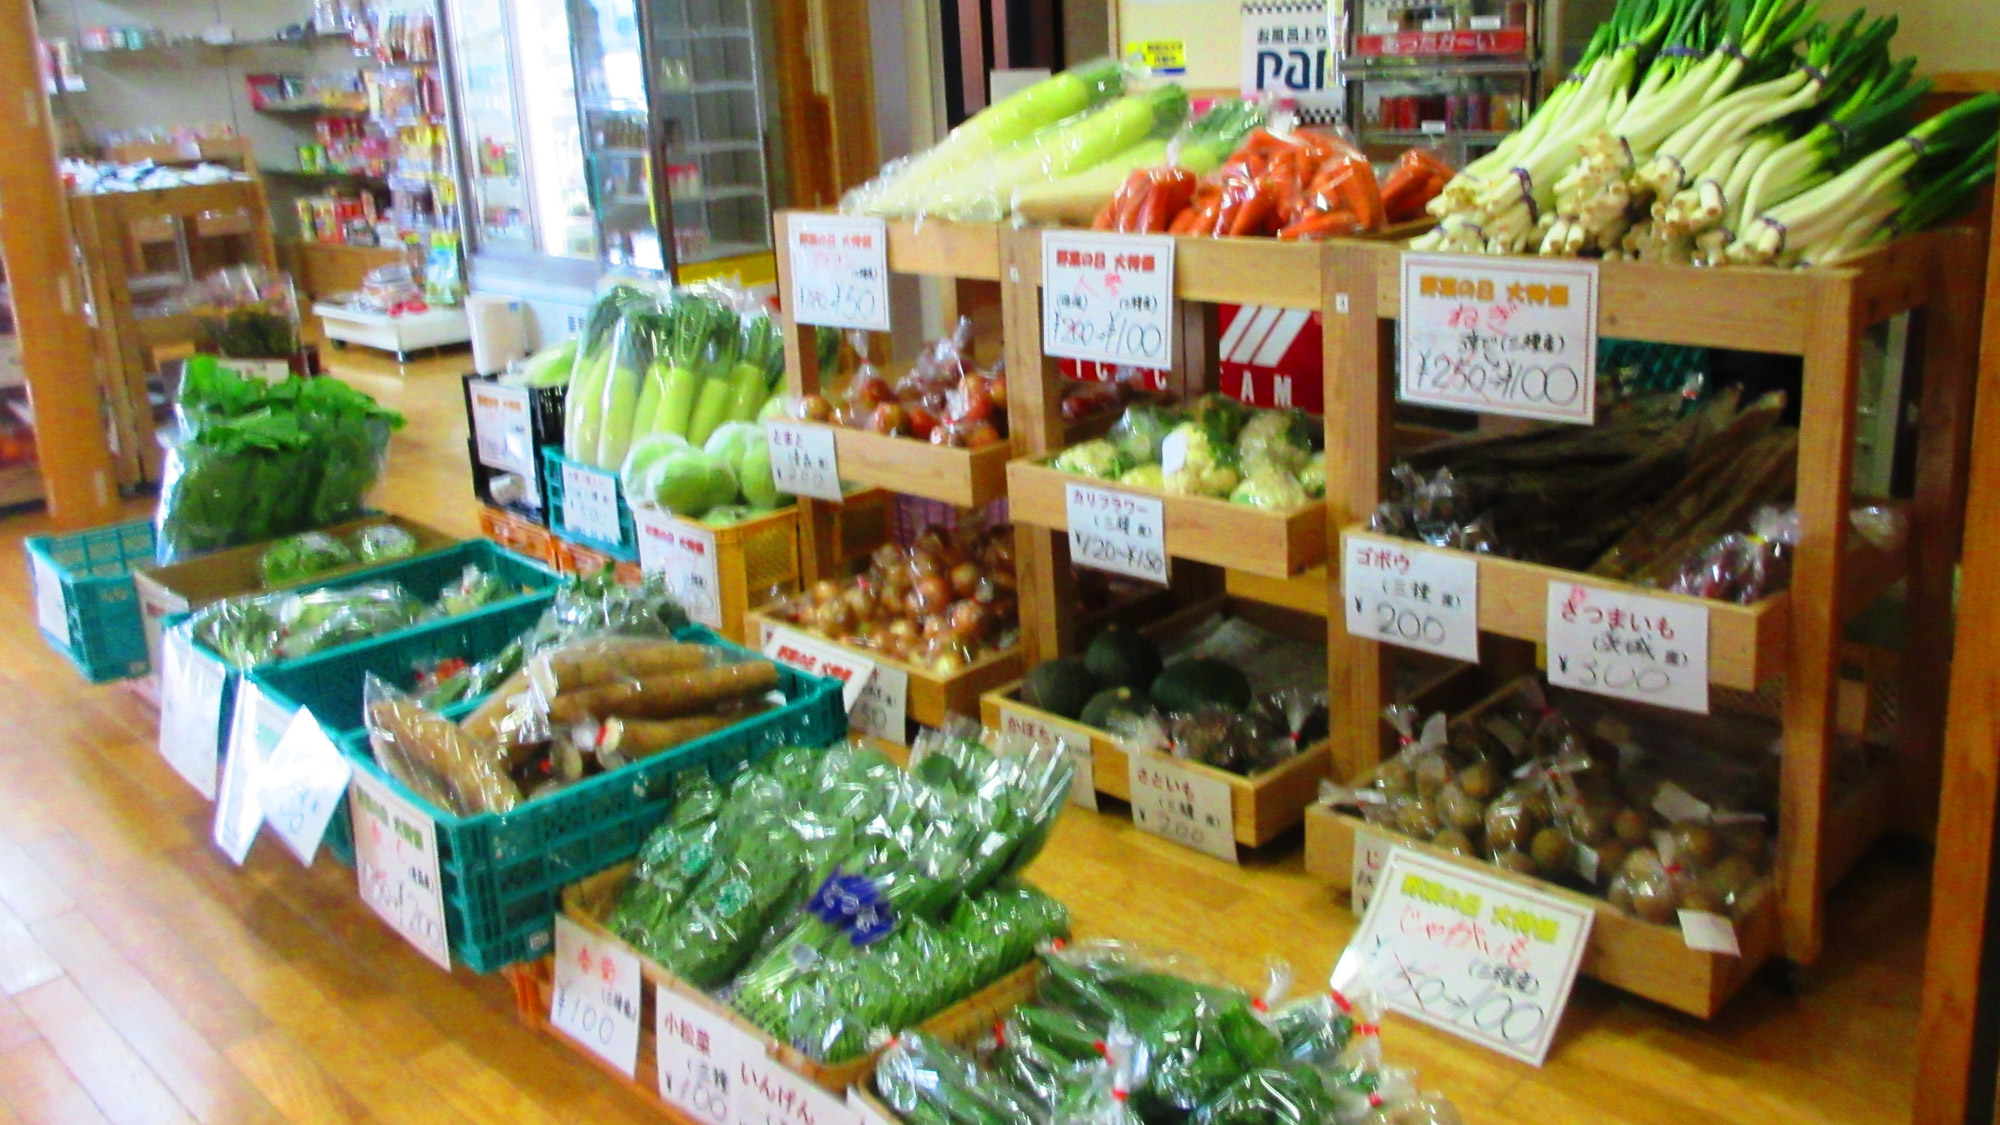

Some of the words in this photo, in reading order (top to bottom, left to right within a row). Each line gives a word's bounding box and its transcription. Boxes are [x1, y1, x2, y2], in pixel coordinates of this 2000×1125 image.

[1420, 274, 1495, 302] 野菜の日
[1507, 280, 1570, 307] 大特価
[1356, 546, 1411, 575] ゴボウ
[663, 1009, 711, 1057] 小松菜
